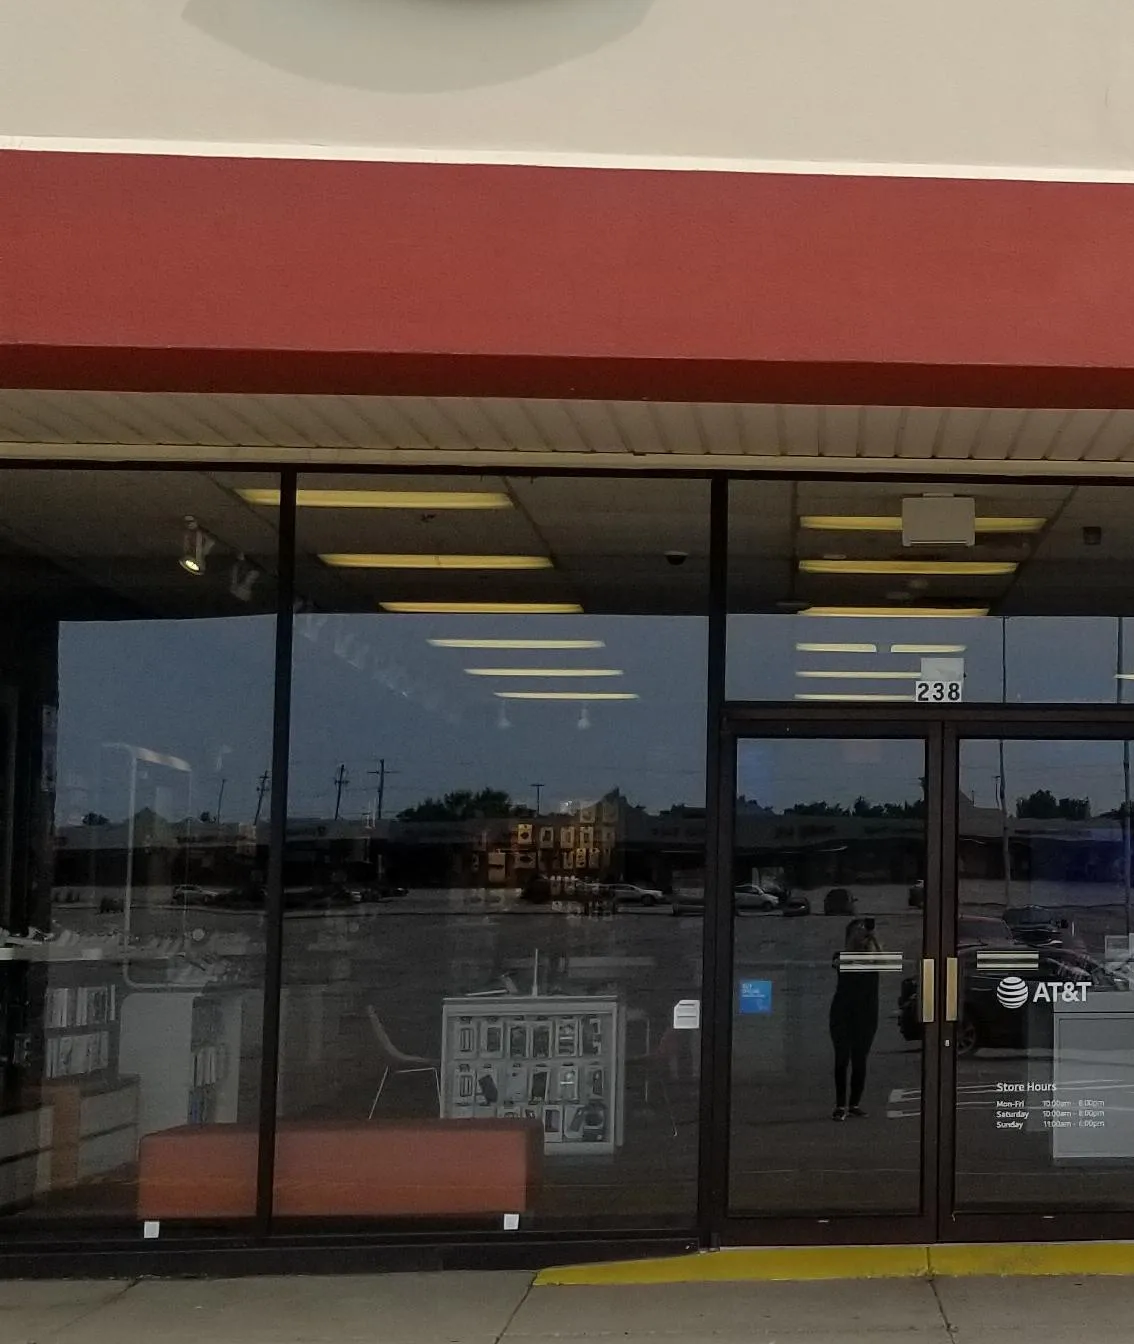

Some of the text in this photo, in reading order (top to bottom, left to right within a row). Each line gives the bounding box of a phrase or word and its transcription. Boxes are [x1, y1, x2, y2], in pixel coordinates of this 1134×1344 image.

[917, 682, 960, 701] 238
[1032, 981, 1092, 1003] AT&T
[996, 1082, 1057, 1092] Store Hours
[996, 1100, 1025, 1108] Mon-Fri
[996, 1110, 1030, 1120] Saturday
[996, 1121, 1024, 1130] Sunday
